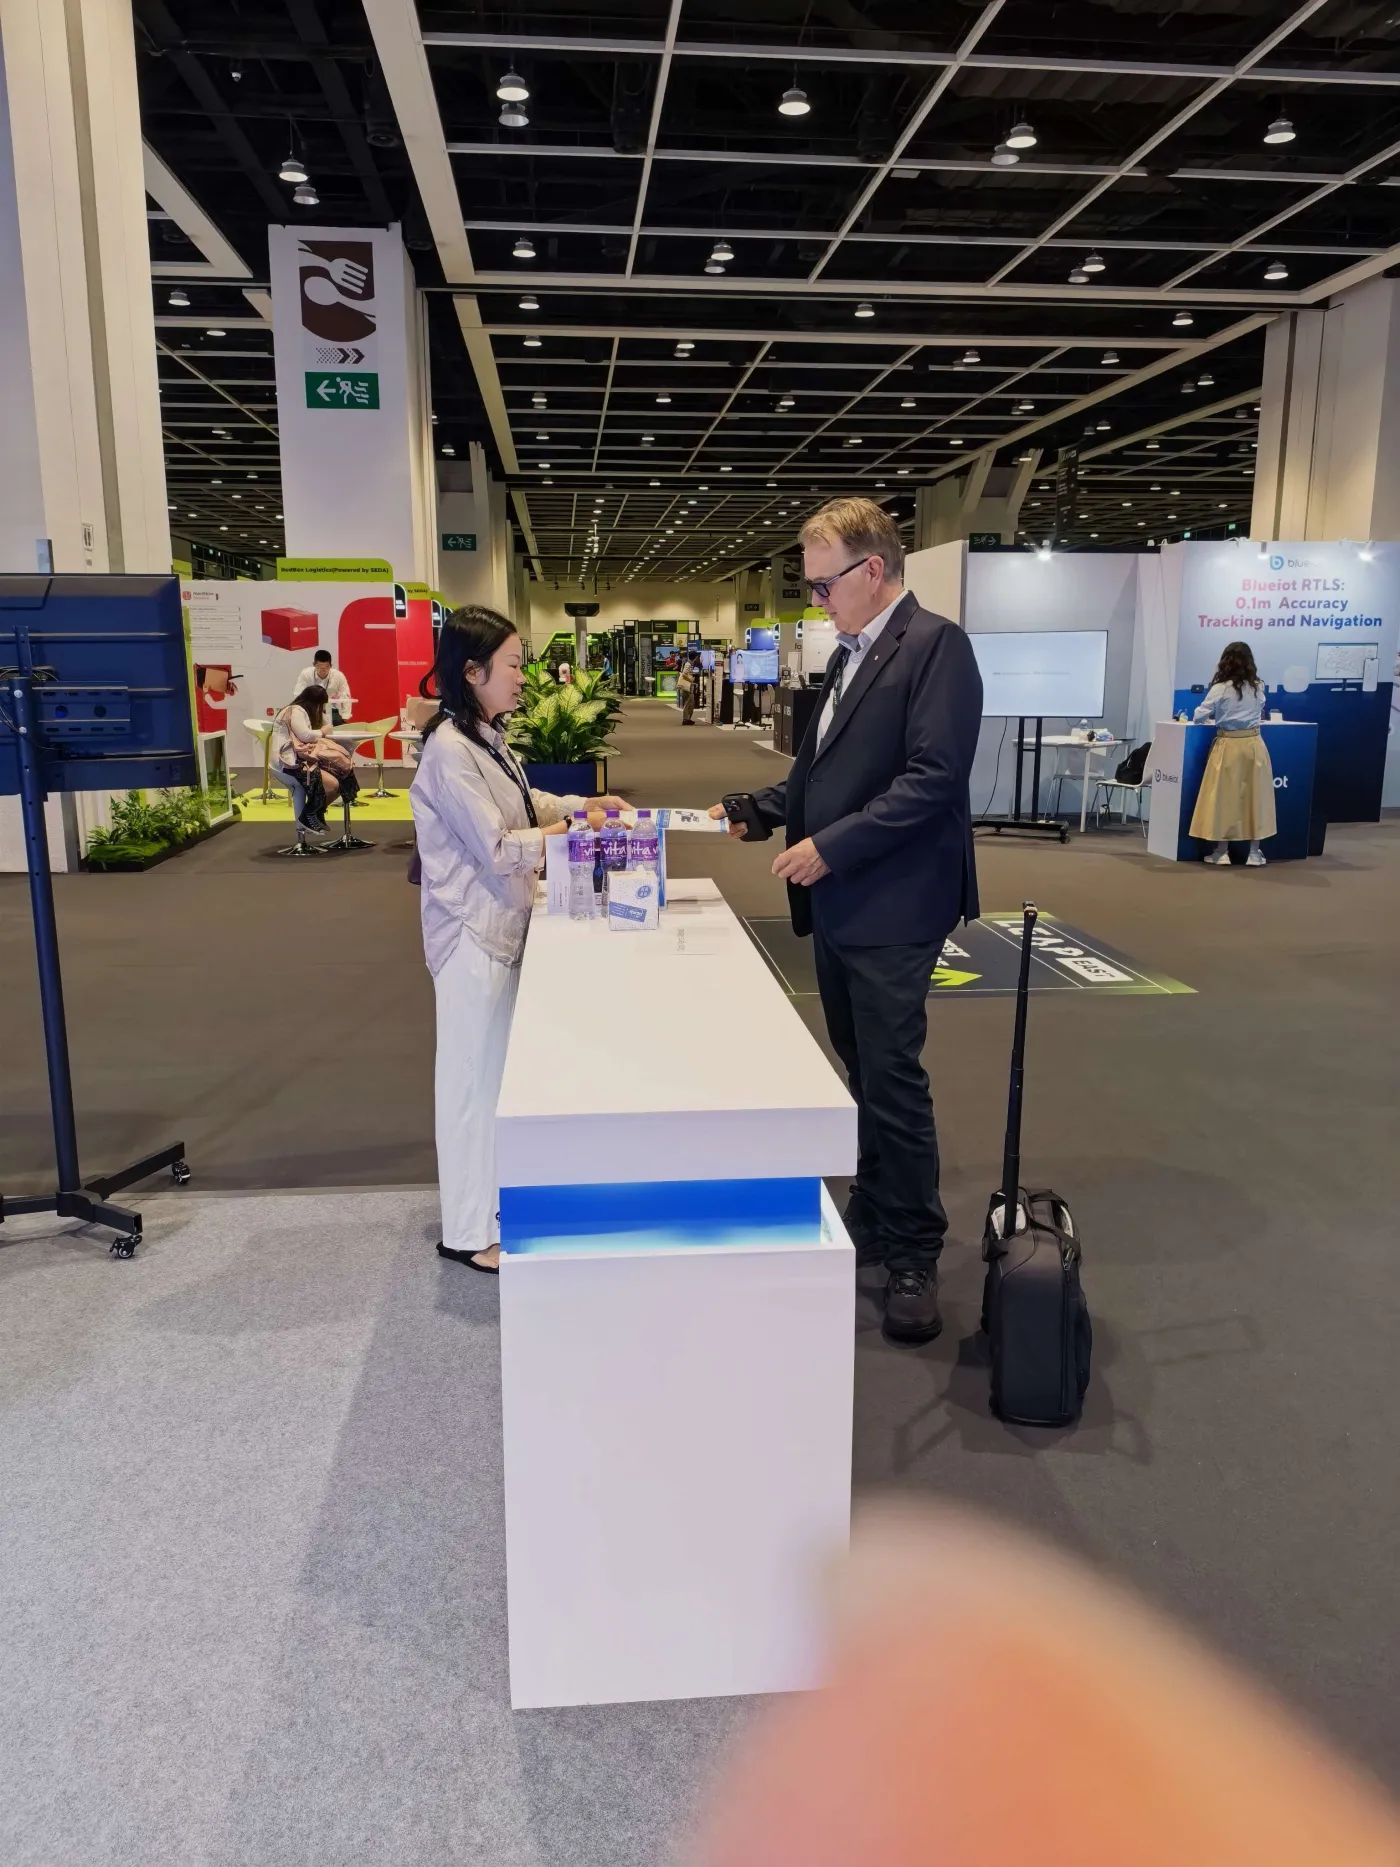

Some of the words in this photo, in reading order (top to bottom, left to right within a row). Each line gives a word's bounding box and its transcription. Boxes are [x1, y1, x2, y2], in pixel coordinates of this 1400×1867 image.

[305, 566, 361, 574] Logistics(Powered
[1241, 578, 1297, 592] Blueiot
[1301, 578, 1345, 592] RTLS:
[1235, 596, 1271, 610] 0.1m
[1278, 596, 1349, 612] Accuracy
[1198, 614, 1263, 631] Tracking
[1268, 615, 1296, 628] and
[1300, 614, 1383, 631] Navigation
[991, 920, 1084, 957] LEAP
[1071, 960, 1116, 978] EAST
